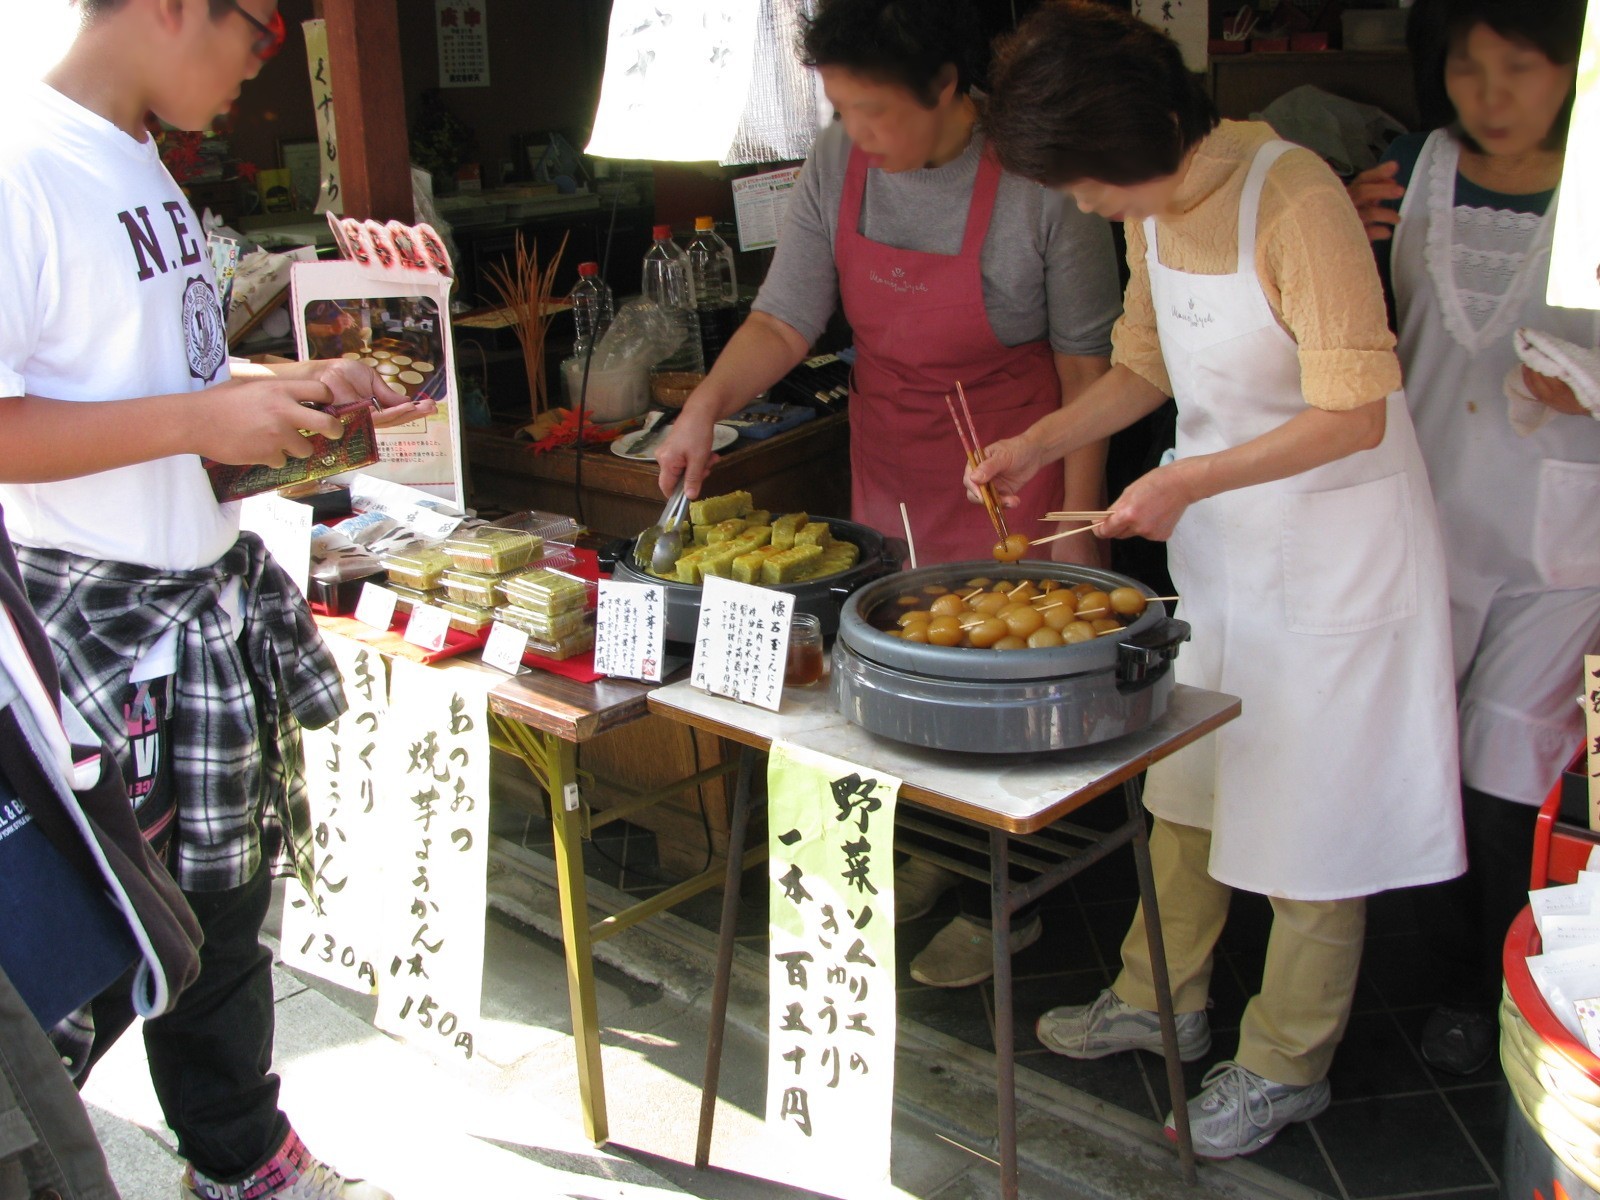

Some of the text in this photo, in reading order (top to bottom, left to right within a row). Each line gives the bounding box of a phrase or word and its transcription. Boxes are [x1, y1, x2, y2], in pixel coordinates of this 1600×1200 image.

[314, 719, 348, 894] ようかん
[354, 649, 386, 814] 手づくり
[447, 691, 475, 852] あつあつ
[406, 731, 450, 954] 焼芋ようかん
[829, 772, 882, 1076] 野菜ソムリエの
[774, 828, 814, 1137] 一本 百五十円
[817, 903, 847, 1089] きゅうり
